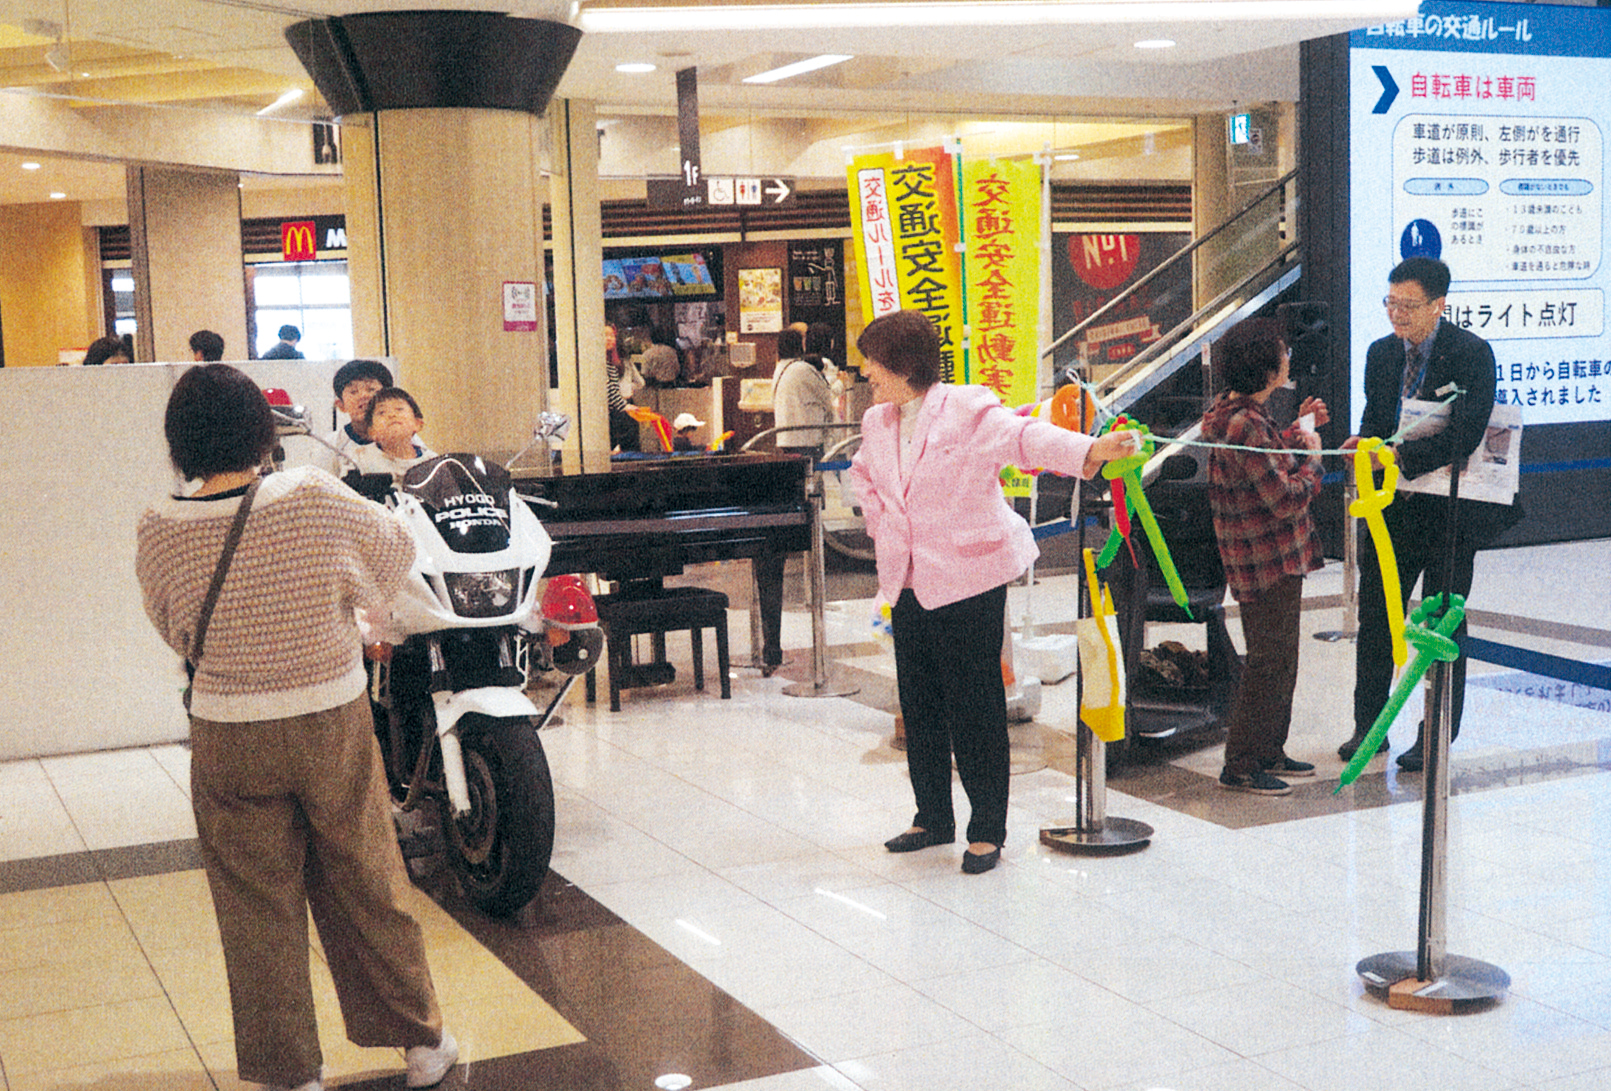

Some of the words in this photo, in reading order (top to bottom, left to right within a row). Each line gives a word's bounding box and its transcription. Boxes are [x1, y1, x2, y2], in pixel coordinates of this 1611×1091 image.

[1411, 72, 1536, 101] 自転車は車両
[444, 494, 495, 508] HYOGO
[435, 507, 508, 523] POLICE
